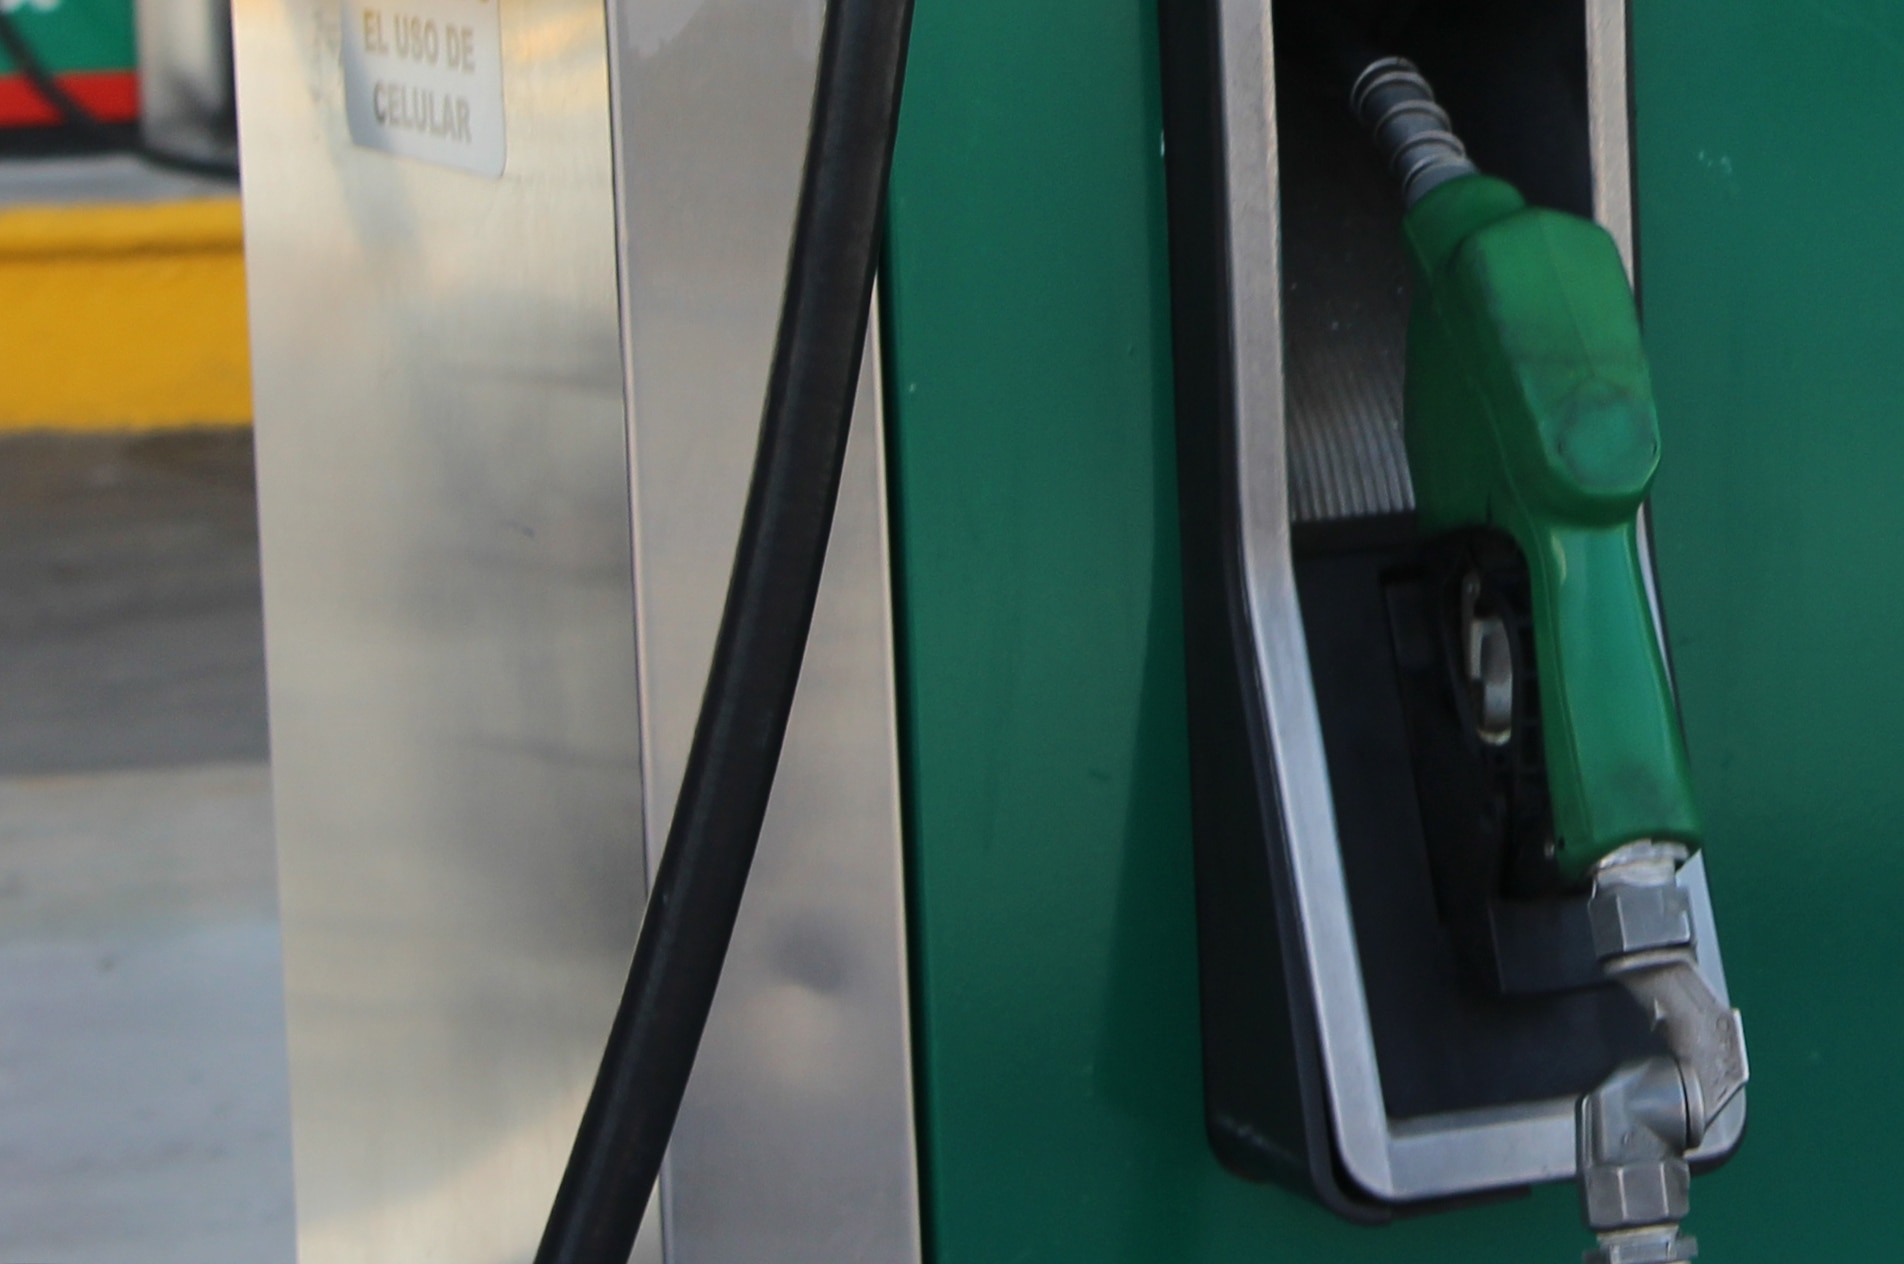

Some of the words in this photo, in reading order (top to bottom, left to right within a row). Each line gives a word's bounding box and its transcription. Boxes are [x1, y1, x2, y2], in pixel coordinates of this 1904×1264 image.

[363, 8, 389, 56] EL
[394, 14, 439, 67] USO
[446, 24, 476, 73] DE
[374, 79, 472, 143] CELULAR
